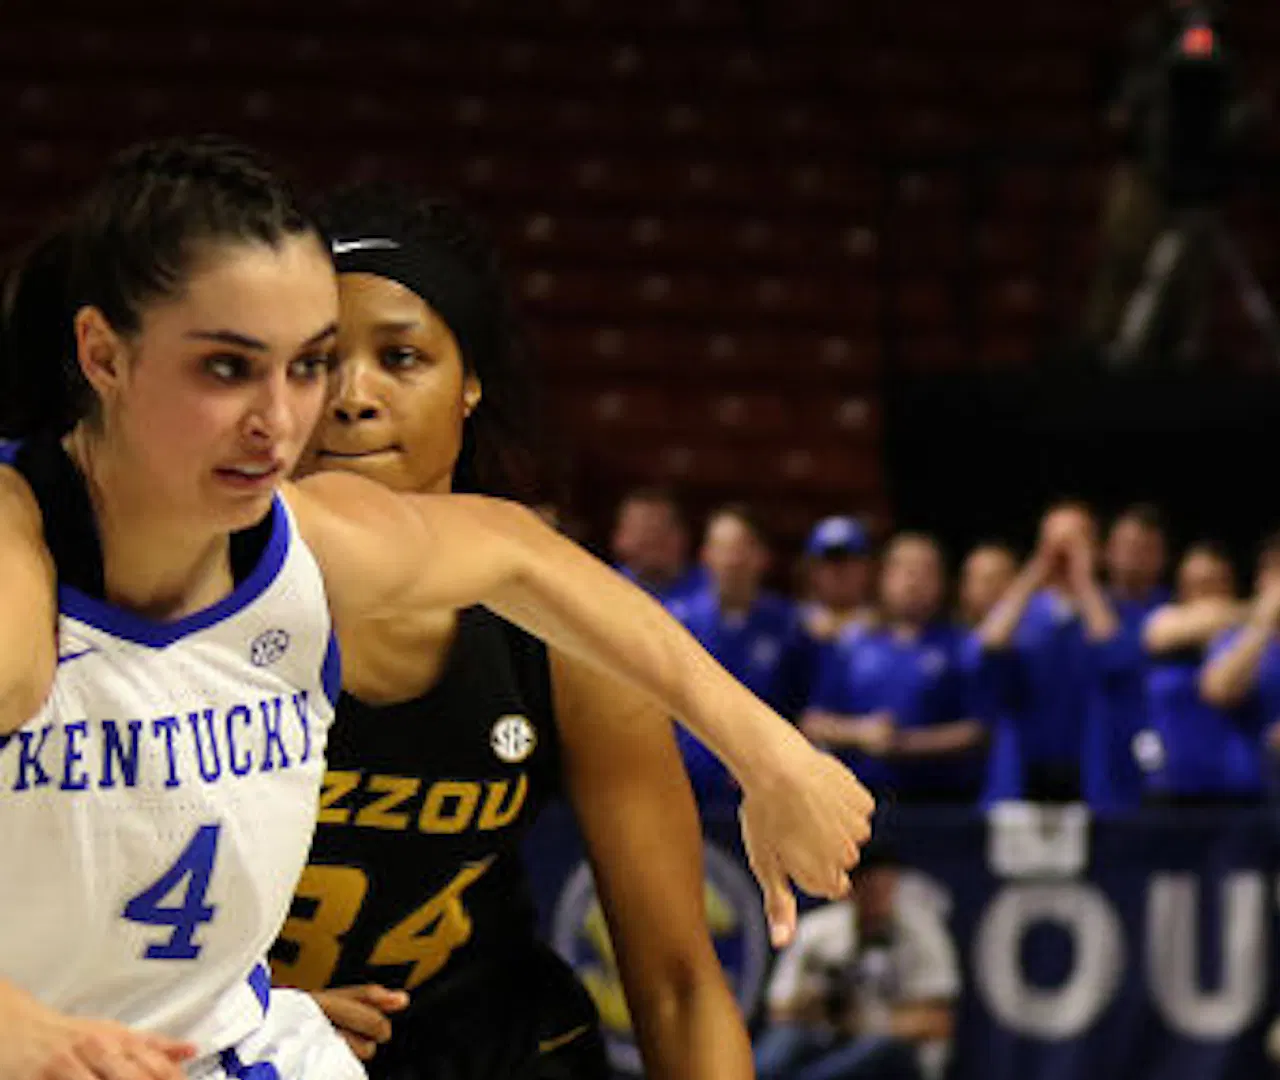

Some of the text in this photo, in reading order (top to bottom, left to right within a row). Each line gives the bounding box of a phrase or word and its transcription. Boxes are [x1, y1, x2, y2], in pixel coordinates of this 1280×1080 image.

[12, 690, 314, 792] KENTUCKY
[318, 769, 528, 835] ZZOU
[119, 823, 222, 961] 4
[268, 853, 498, 991] 34
